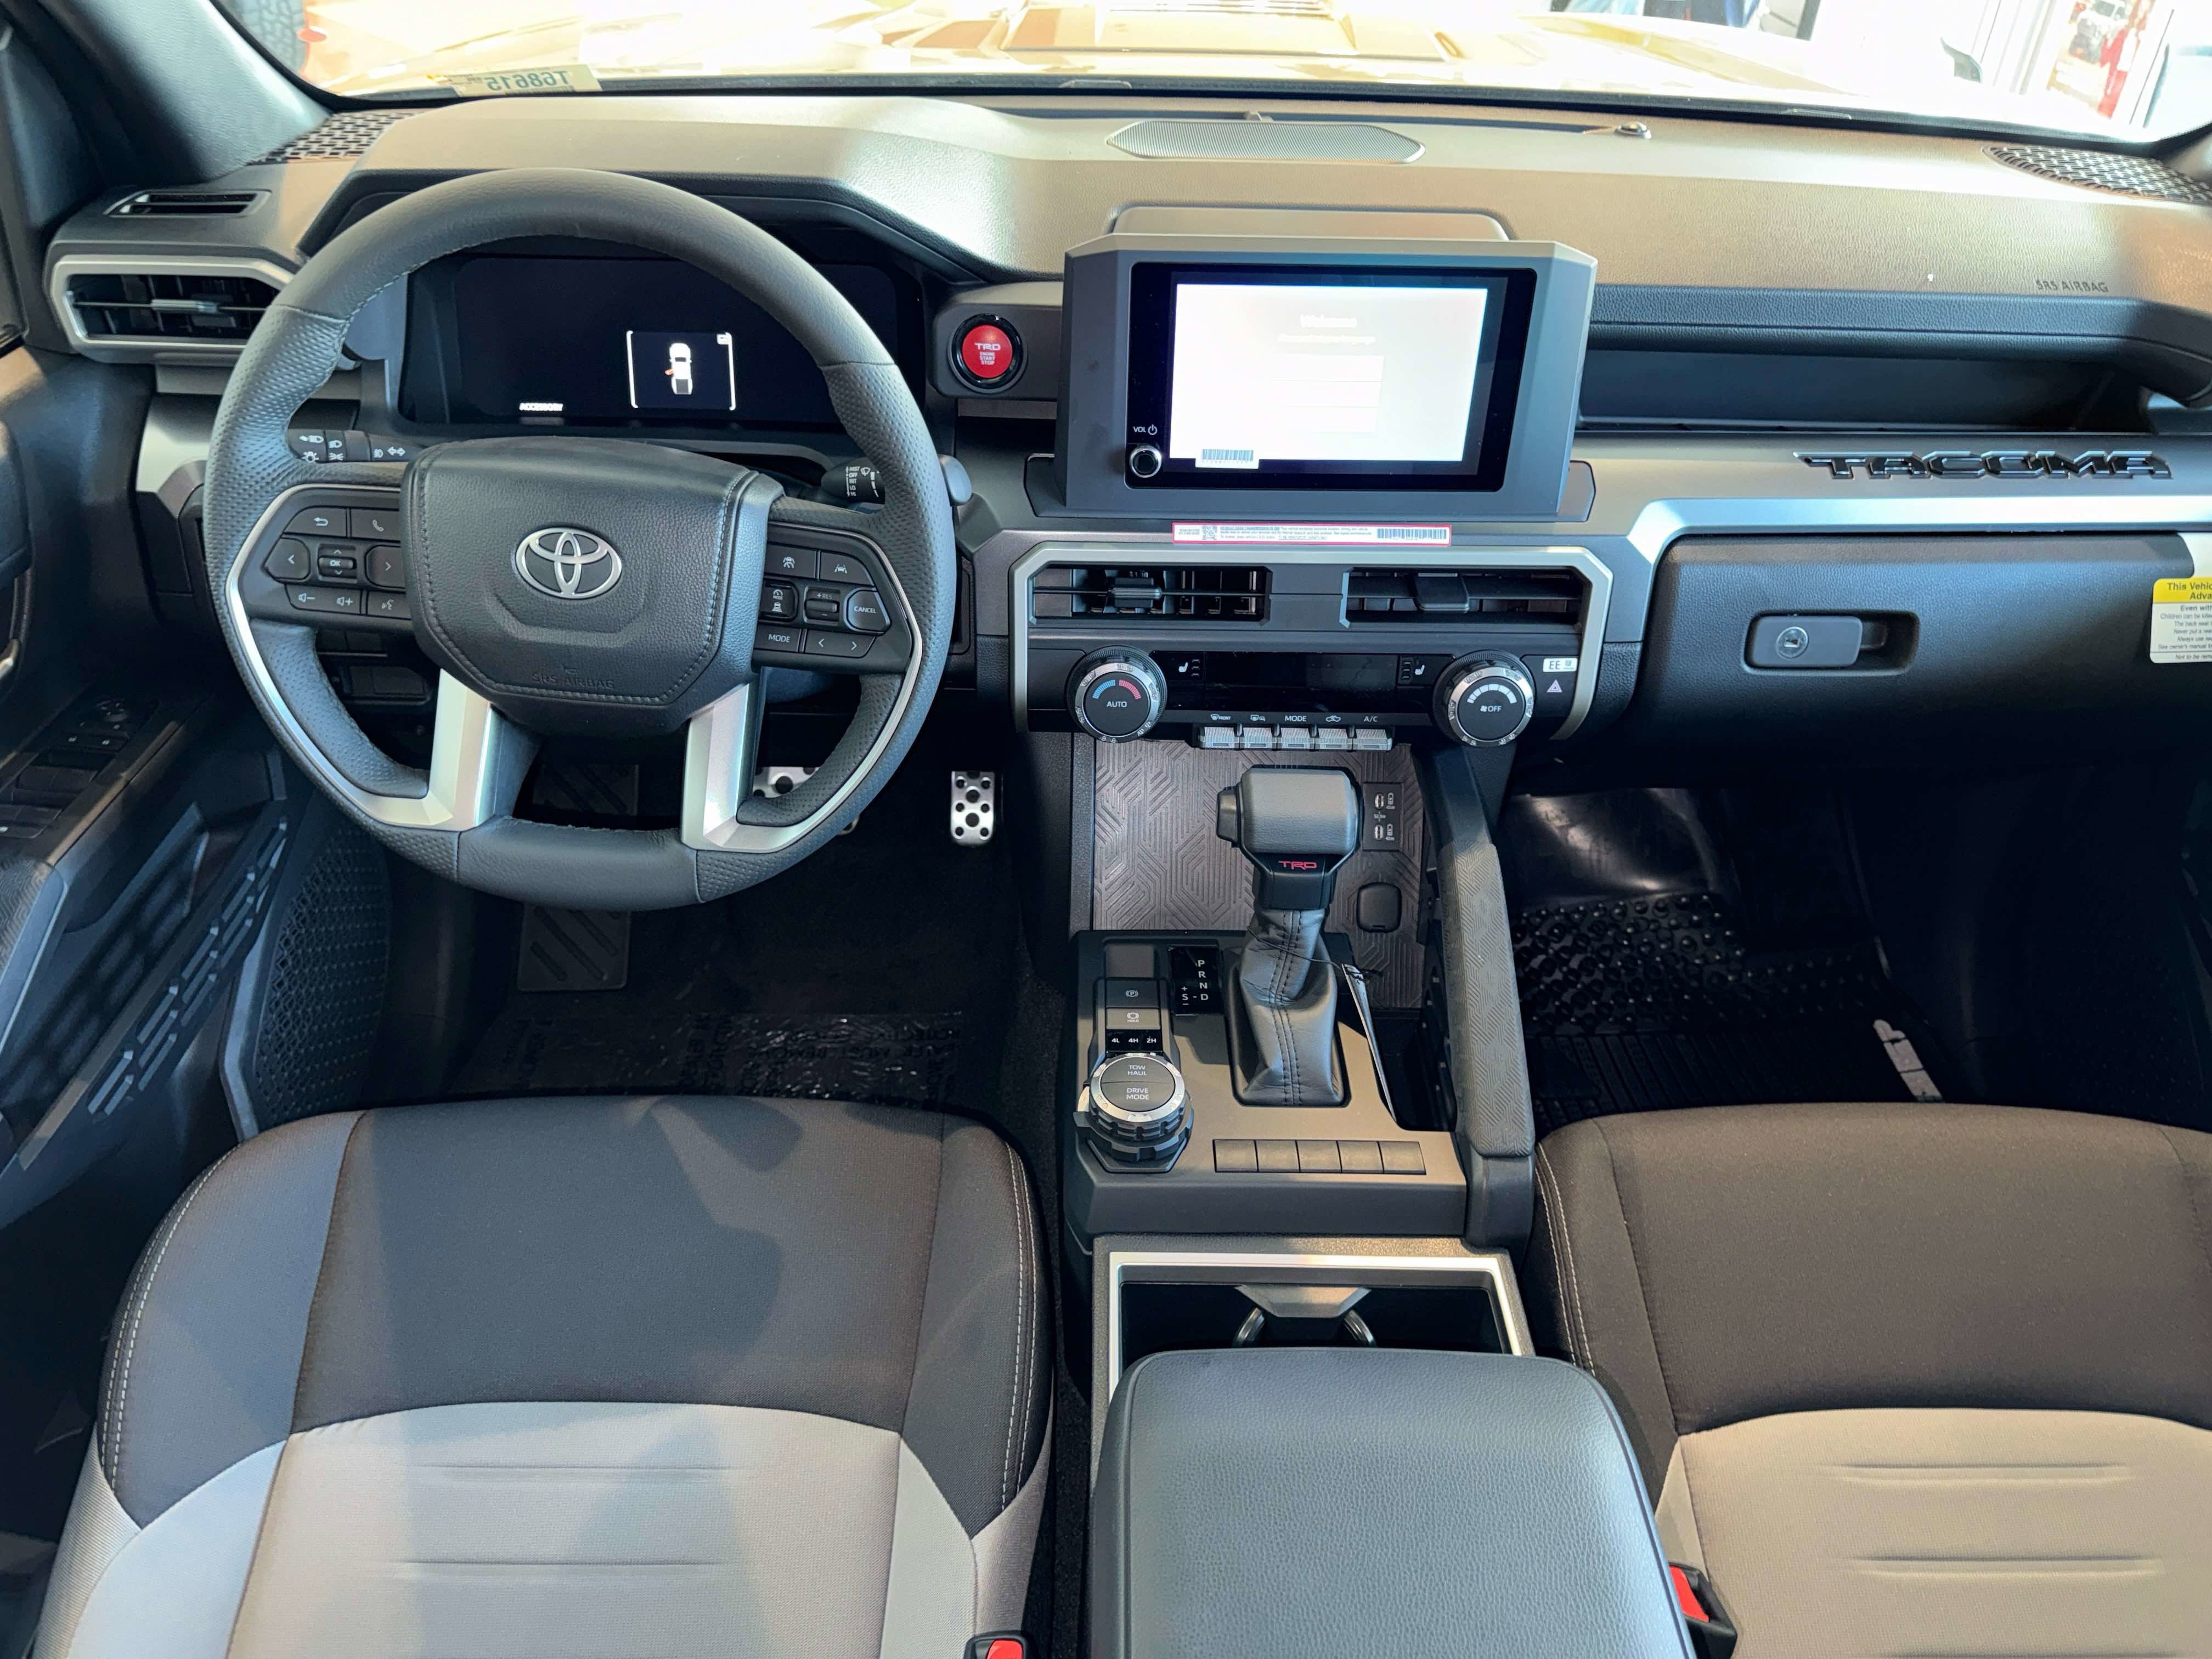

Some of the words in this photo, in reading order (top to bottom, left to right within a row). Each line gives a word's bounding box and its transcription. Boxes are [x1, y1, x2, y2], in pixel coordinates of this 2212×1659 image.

[2035, 280, 2058, 291] SRS
[2061, 281, 2109, 293] AIRBAG
[974, 342, 1001, 351] TRD
[1792, 450, 2174, 480] TACOMA
[2168, 582, 2186, 591] This
[854, 606, 877, 614] CANCEL
[768, 634, 791, 643] MODE
[1549, 660, 1561, 670] EE
[532, 672, 557, 685] SRS
[565, 675, 614, 690] AIRBAG
[1278, 860, 1317, 870] TRD
